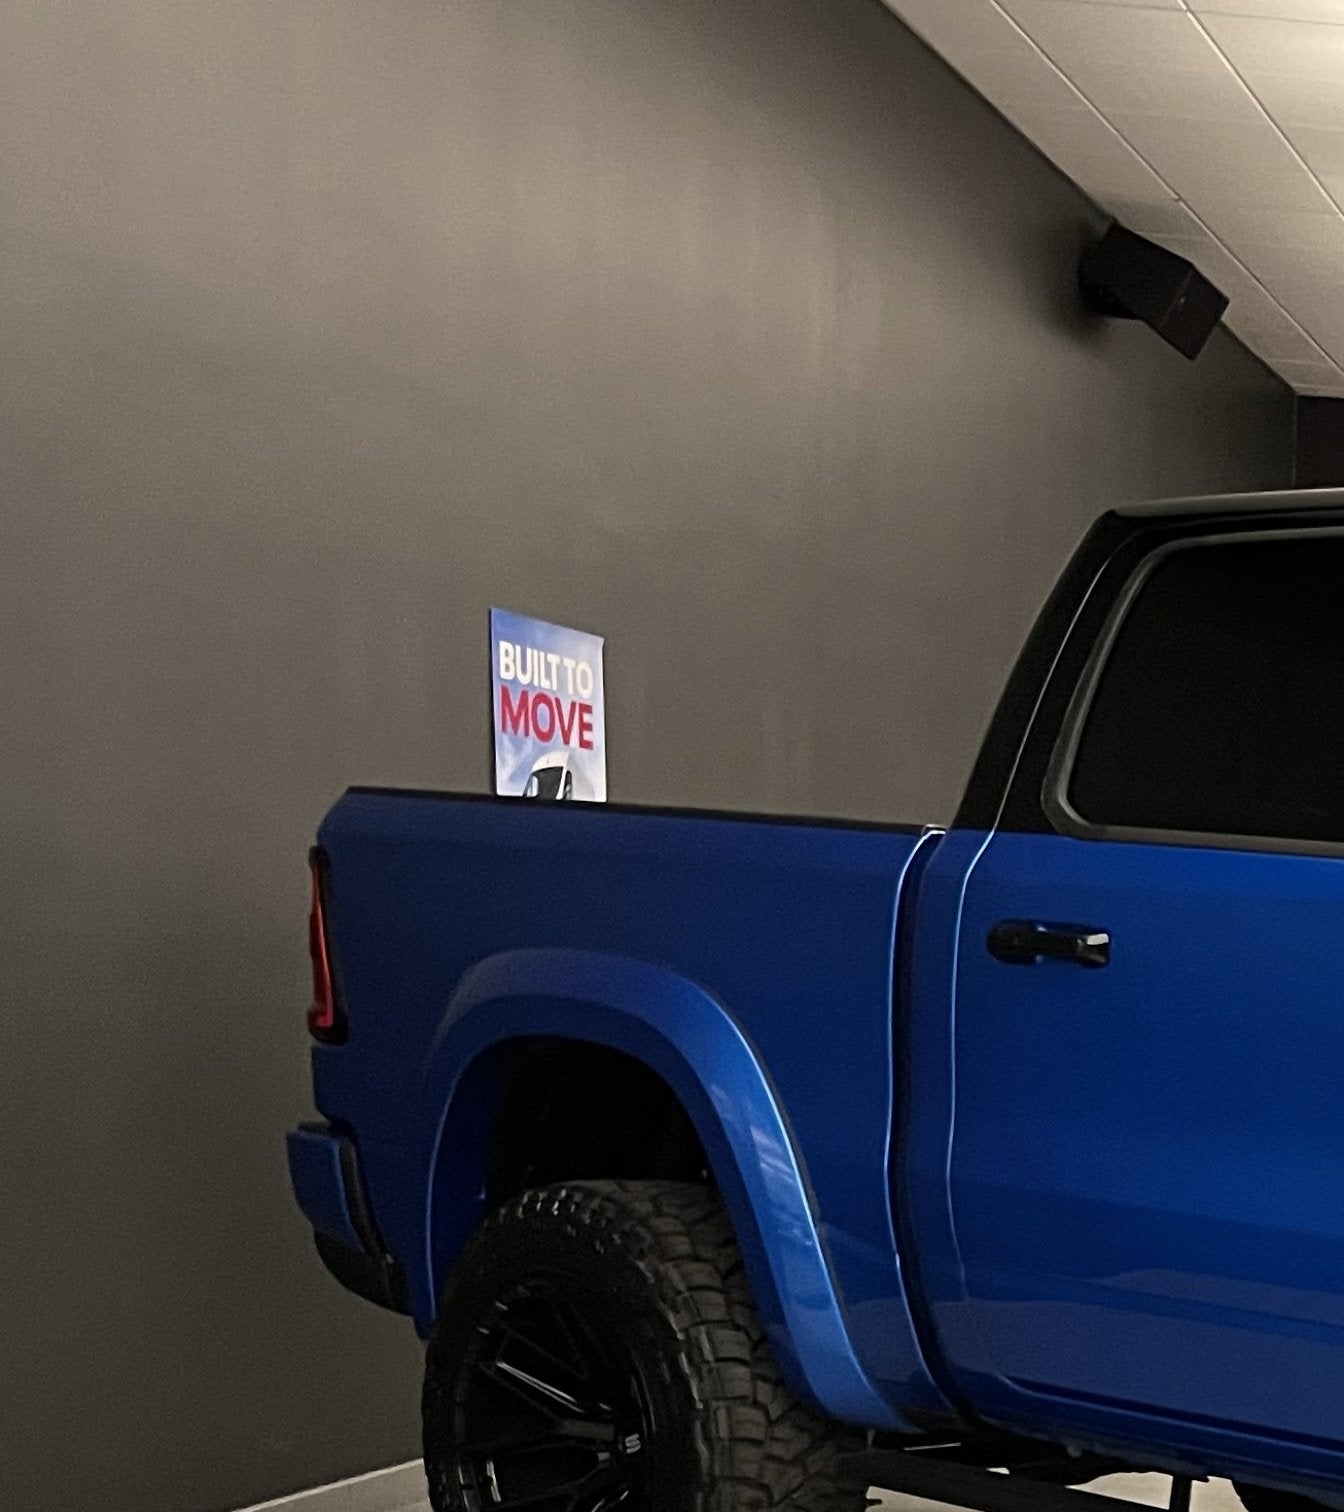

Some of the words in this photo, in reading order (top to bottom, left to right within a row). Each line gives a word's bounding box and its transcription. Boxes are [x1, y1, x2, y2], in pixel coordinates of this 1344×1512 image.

[498, 640, 560, 691] BUILT
[563, 657, 594, 698] TO
[500, 684, 594, 751] MOVE
